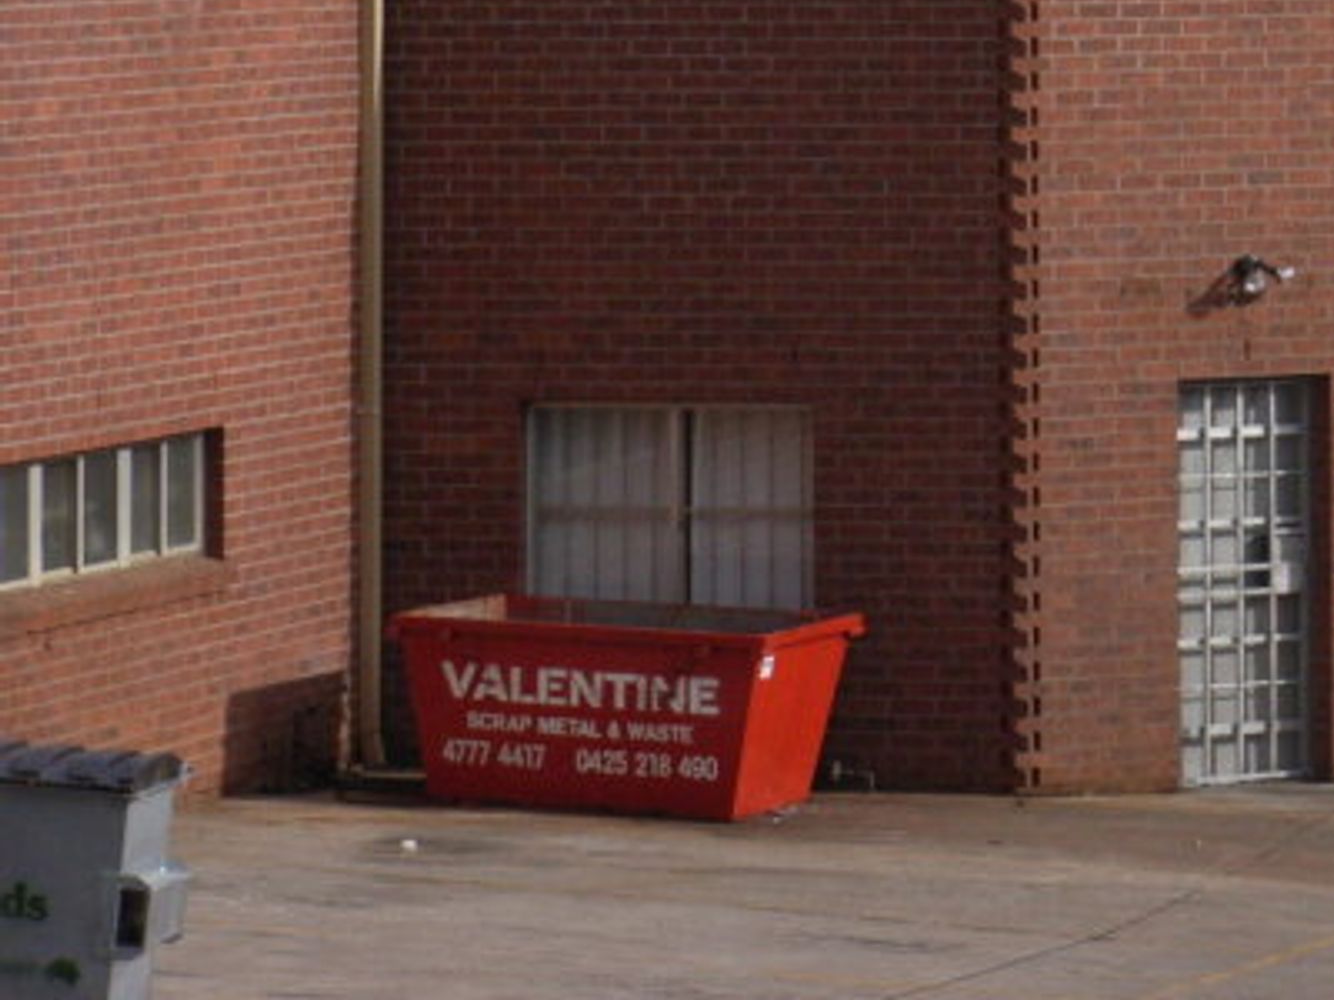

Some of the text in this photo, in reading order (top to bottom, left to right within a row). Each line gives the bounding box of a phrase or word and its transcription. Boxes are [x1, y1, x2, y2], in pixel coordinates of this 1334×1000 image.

[441, 660, 720, 715] VALENTINE
[466, 710, 694, 744] SCRAP METAL & WASTE
[443, 739, 491, 766] 4777
[497, 742, 546, 769] 4417
[576, 750, 628, 775] 0425
[678, 756, 719, 781] 490
